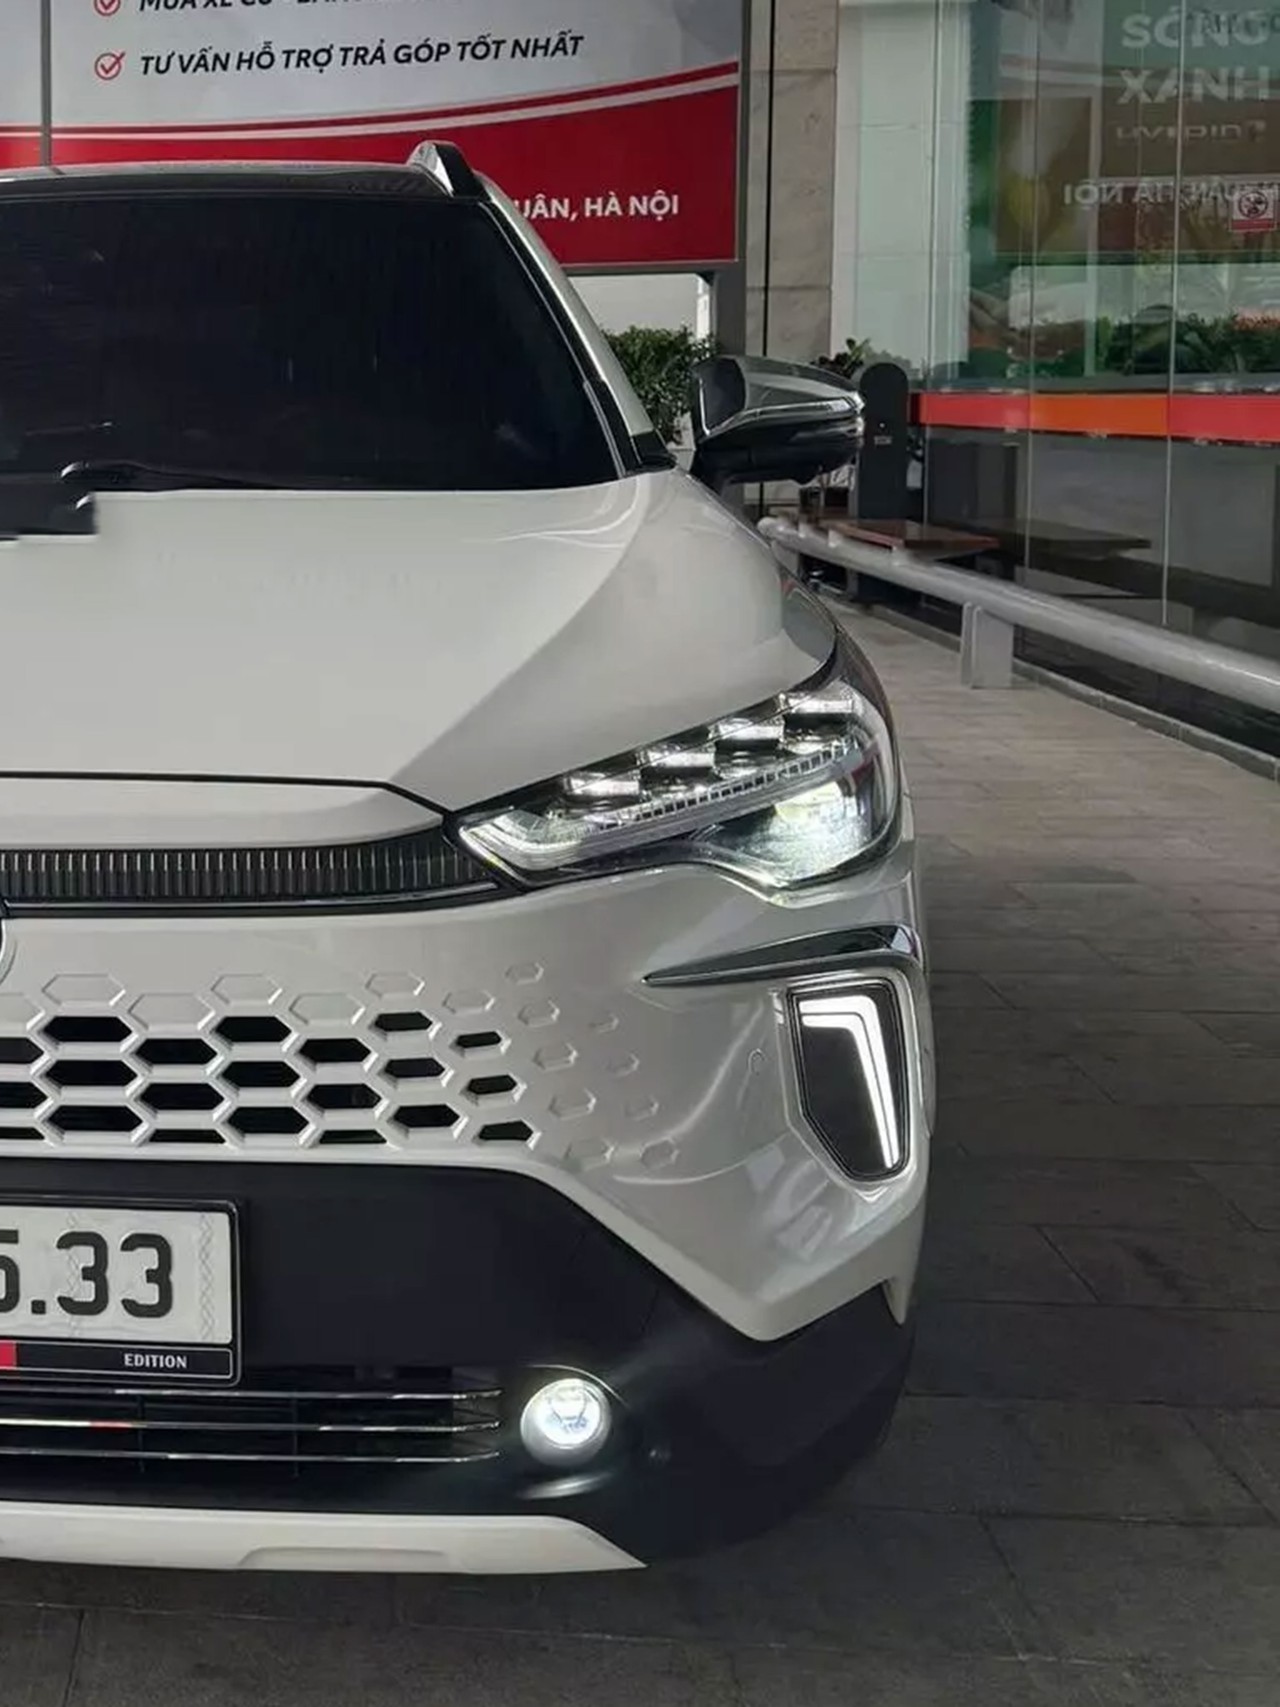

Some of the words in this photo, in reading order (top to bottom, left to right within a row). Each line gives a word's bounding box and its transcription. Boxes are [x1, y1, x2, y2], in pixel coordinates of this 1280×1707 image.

[141, 52, 175, 75] TƯ
[177, 47, 230, 74] VẤN
[236, 40, 276, 72] HỖ
[282, 46, 336, 74] TRỢ
[339, 41, 388, 68] TRẢ
[393, 38, 451, 65] GÓP
[457, 34, 506, 62] TỐT
[511, 31, 585, 60] NHẤT
[584, 191, 622, 217] HÀ
[629, 189, 679, 222] NỘI
[123, 1352, 187, 1369] EDITION
